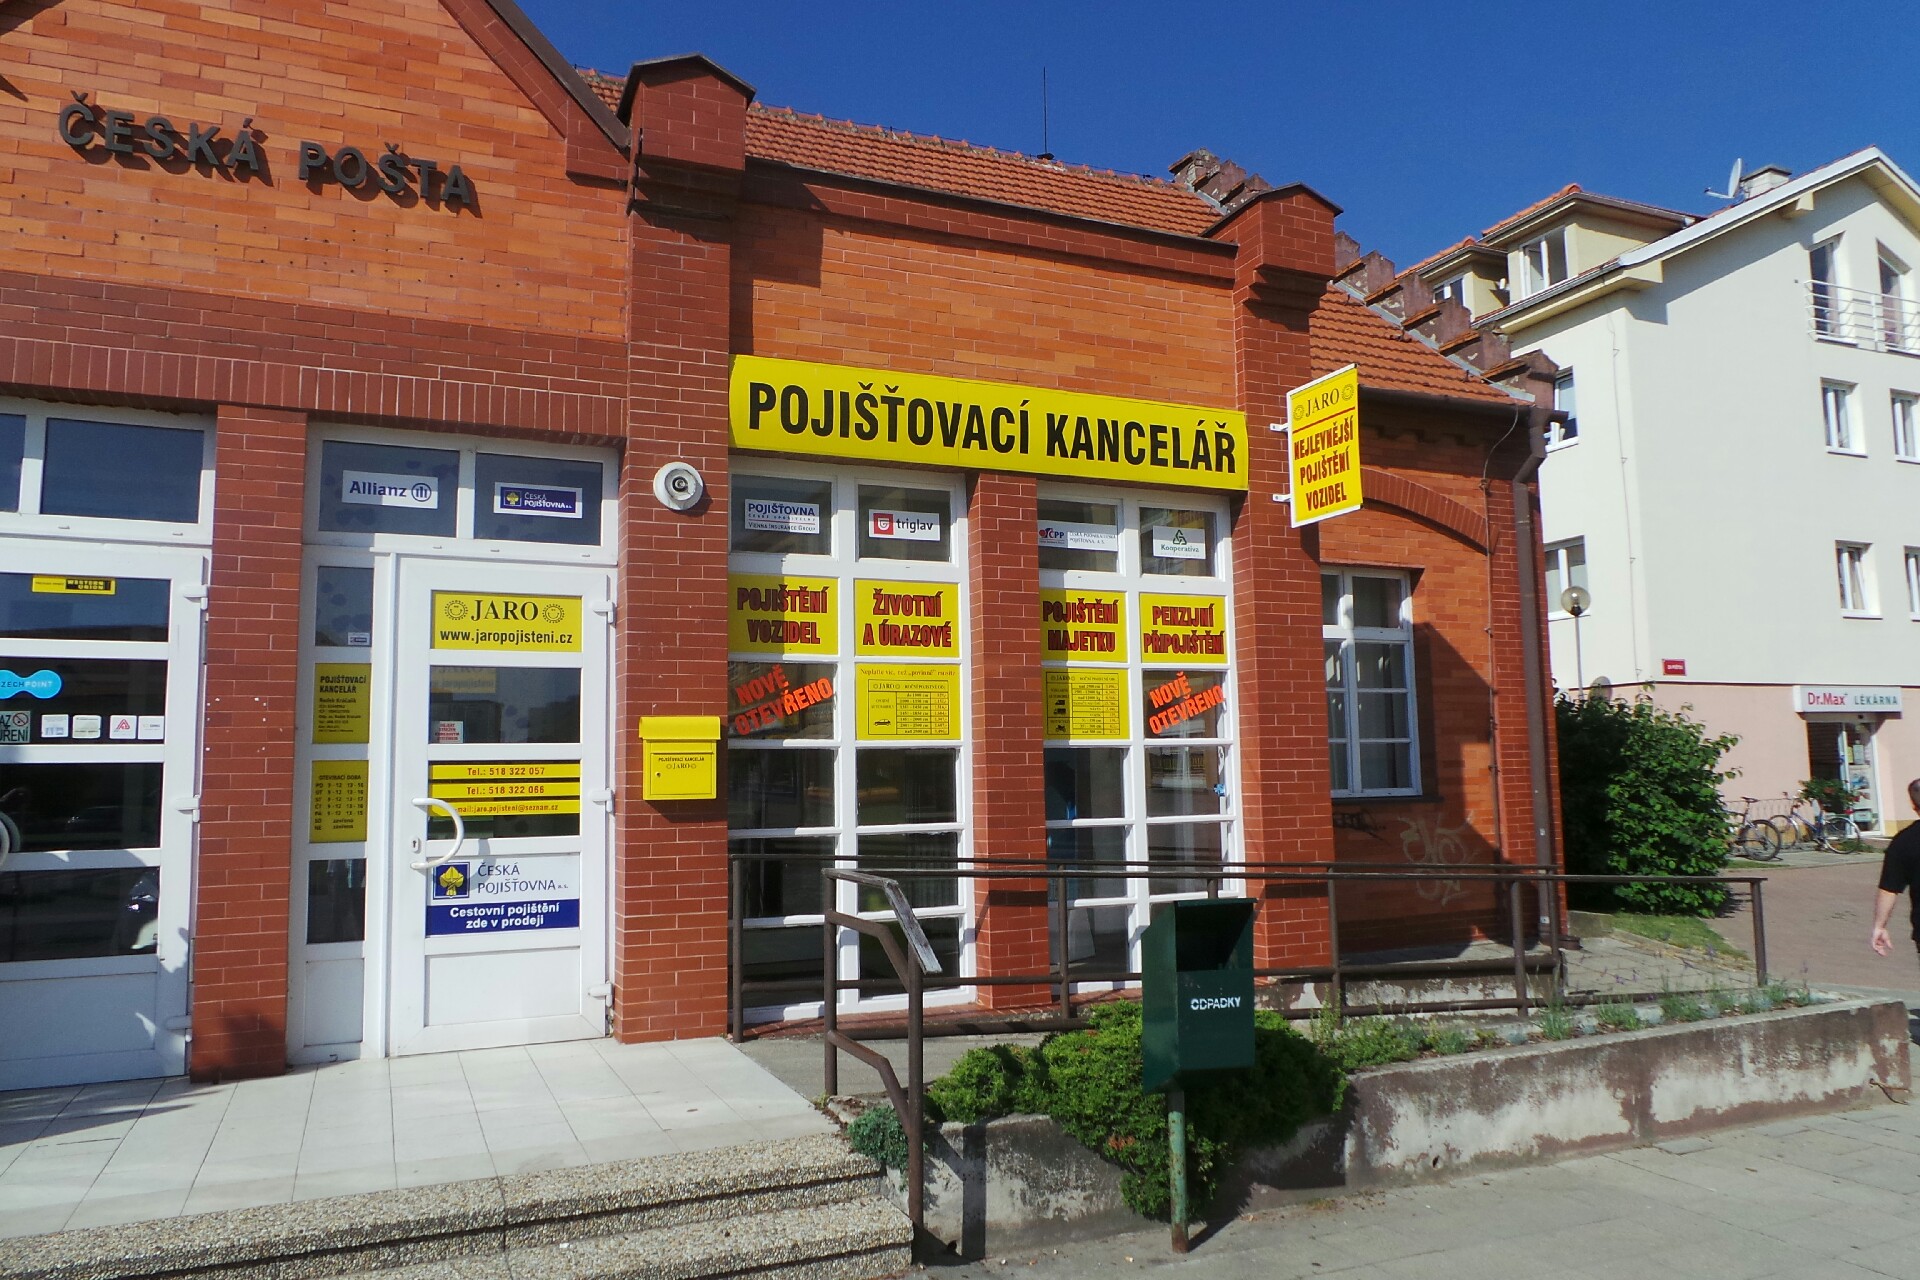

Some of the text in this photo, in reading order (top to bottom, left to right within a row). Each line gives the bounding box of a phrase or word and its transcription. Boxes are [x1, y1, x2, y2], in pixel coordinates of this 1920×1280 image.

[59, 90, 470, 204] ČESKÁ POŠTA
[1305, 388, 1340, 417] JARO
[749, 381, 1236, 474] POJIŠŤOVACÍ KANCELÁŘ
[1294, 415, 1354, 460] NEJLEVNĚJŠÍ
[1300, 445, 1350, 485] POJIŠTĚNÍ
[349, 481, 407, 498] Allianz
[524, 491, 546, 500] ČESKÁ
[1305, 481, 1347, 511] VOZIDEL
[524, 500, 565, 509] POJIŠŤOVNA
[748, 503, 815, 516] POJIŠŤOVNA
[896, 518, 934, 533] triglav
[1160, 544, 1200, 553] Kooperativa
[736, 584, 829, 613] POJIŠTĚNÍ
[872, 588, 943, 618] ŽIVOTNÍ
[470, 599, 539, 622] JARO
[1042, 597, 1119, 624] POJIŠTĚNÍ
[1152, 603, 1215, 628] PENZIJNÍ
[440, 628, 573, 646] www.jaropojisteni.cz
[747, 619, 820, 645] VOZIDEL
[862, 619, 952, 648] A ÚRAZOVÉ
[1047, 629, 1116, 652] MAJETKU
[1143, 629, 1226, 655] PŘIPOJIŠTĚNÍ
[320, 675, 367, 683] POJIŠŤOVACÍ
[735, 664, 789, 705] NOVĚ
[1149, 671, 1191, 709] NOVĚ
[735, 677, 834, 735] OTEVŘENO
[1149, 685, 1224, 734] OTEVŘENO
[1807, 692, 1898, 705] Dr.Max LÉKÁRNA
[467, 767, 545, 776] Tel.: 518 322 057
[466, 785, 545, 795] Tel.: 518 322 066
[477, 862, 520, 877] ČESKÁ
[477, 878, 556, 895] POJIŠŤOVNA
[450, 902, 560, 918] Cestovní pojištění
[466, 915, 544, 929] zde v prodeji
[1190, 996, 1241, 1010] ODPADKY
